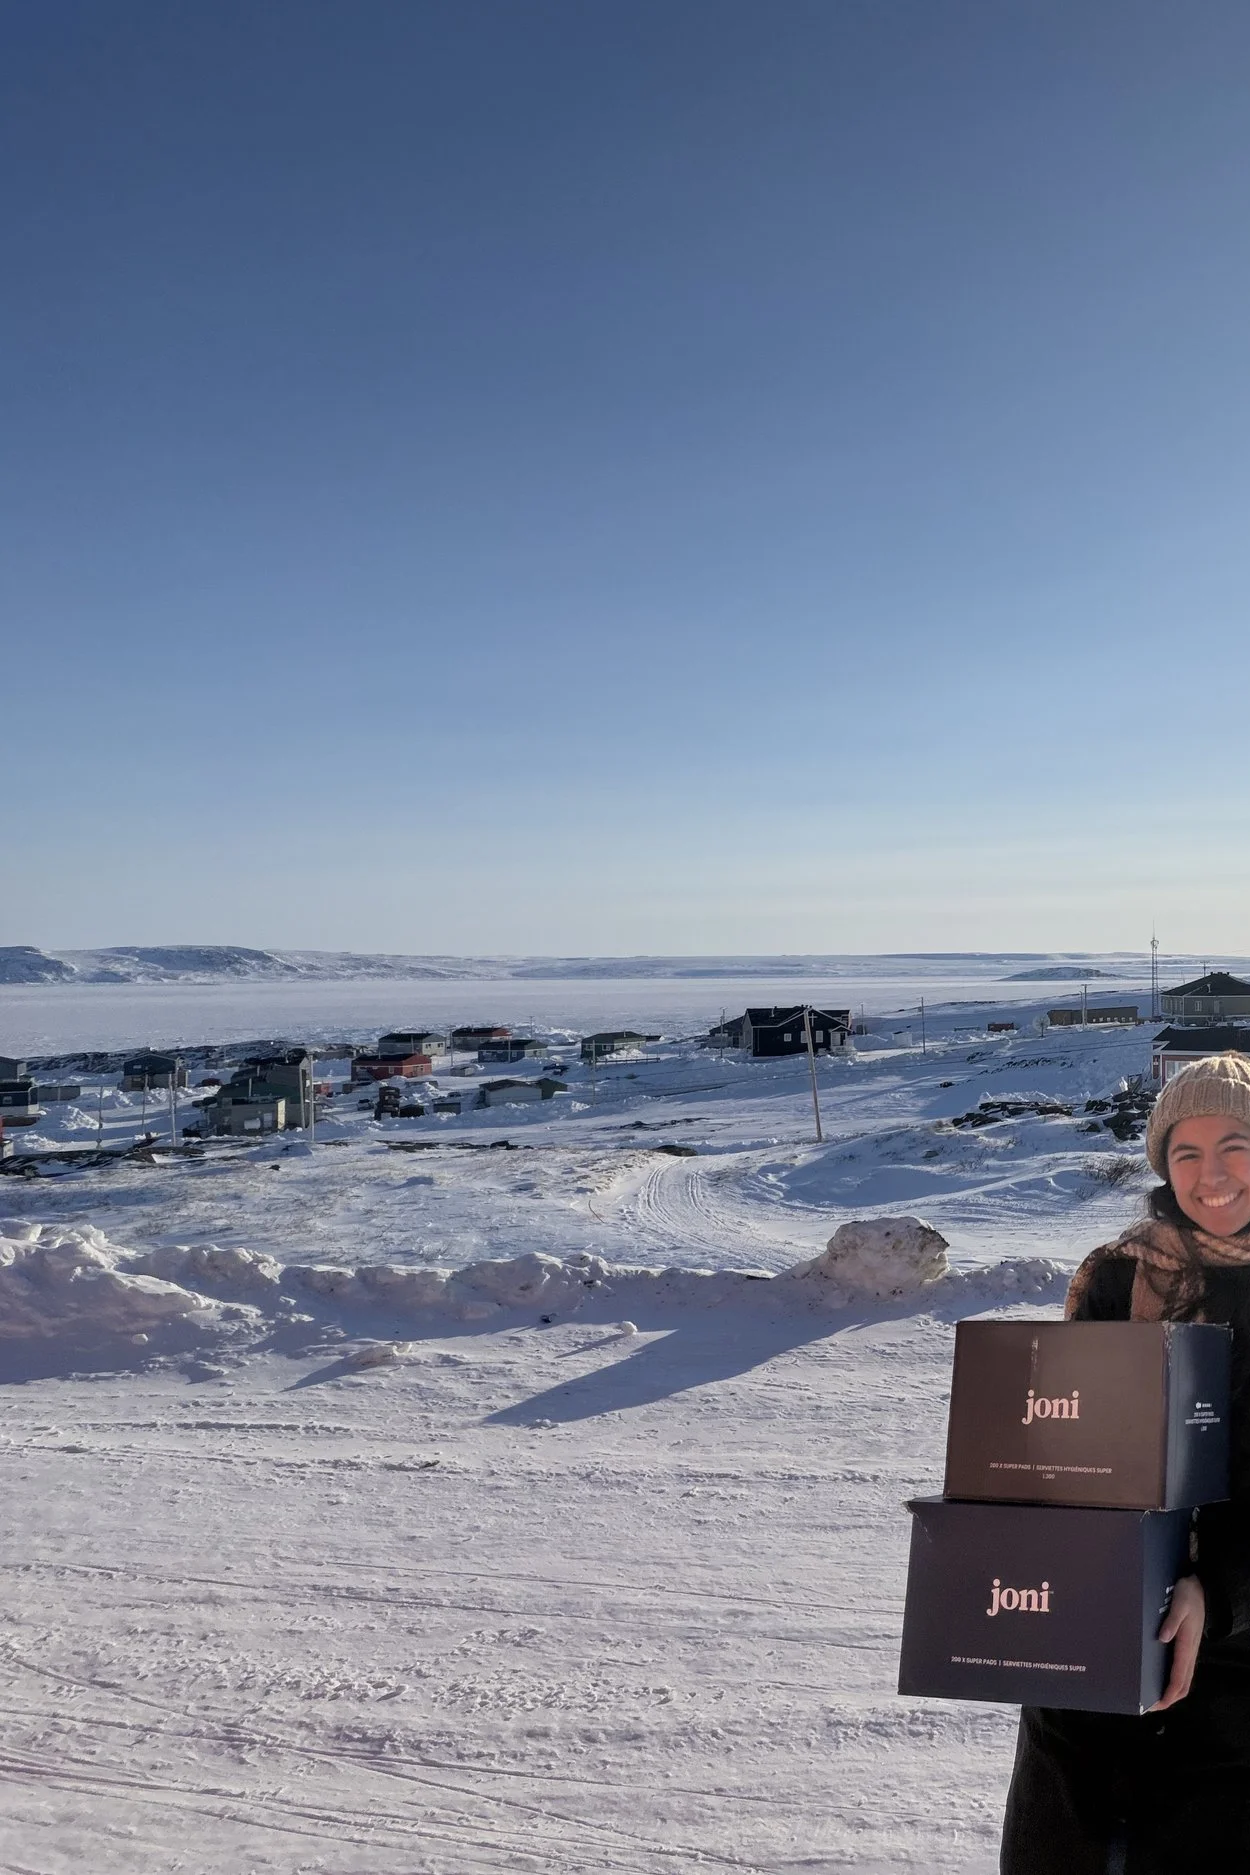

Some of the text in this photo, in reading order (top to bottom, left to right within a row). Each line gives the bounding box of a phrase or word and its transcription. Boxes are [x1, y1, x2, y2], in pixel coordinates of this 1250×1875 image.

[1021, 1389, 1080, 1425] joni
[986, 1578, 1050, 1617] joni
[983, 1658, 997, 1666] PADS
[1002, 1660, 1032, 1668] SERVIETTES
